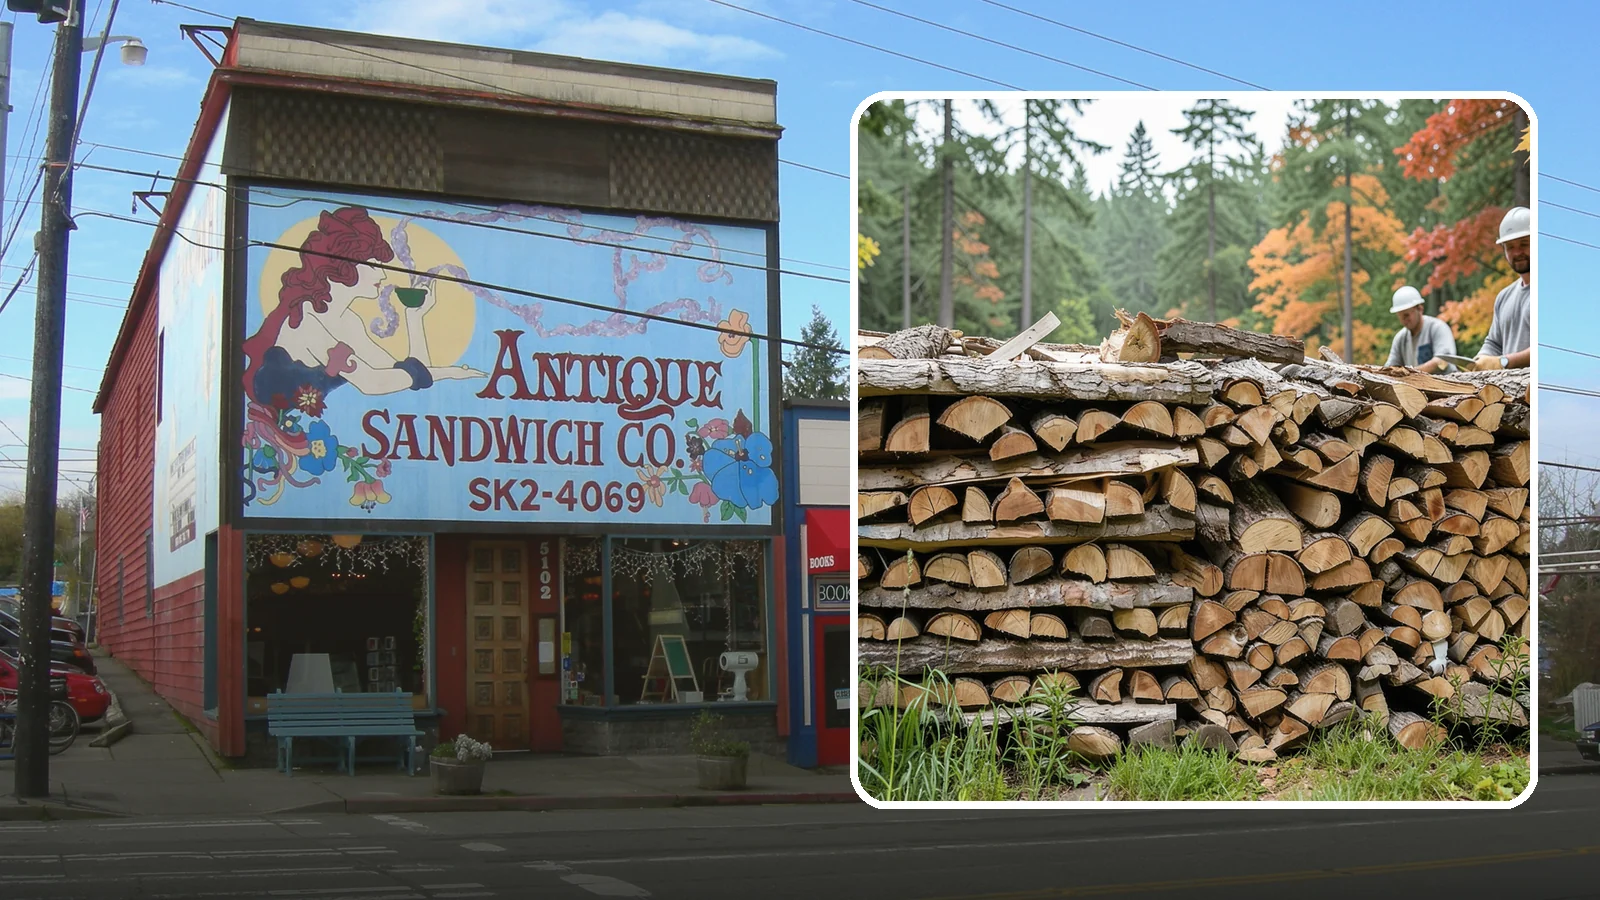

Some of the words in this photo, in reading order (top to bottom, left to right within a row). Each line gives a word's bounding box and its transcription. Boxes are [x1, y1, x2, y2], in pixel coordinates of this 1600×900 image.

[475, 329, 723, 421] ANTIQUE
[361, 408, 605, 468] SANDWICH
[616, 421, 685, 469] CO.
[468, 477, 646, 513] SK2-4069
[539, 541, 552, 600] 5102
[809, 554, 835, 569] BOOKS
